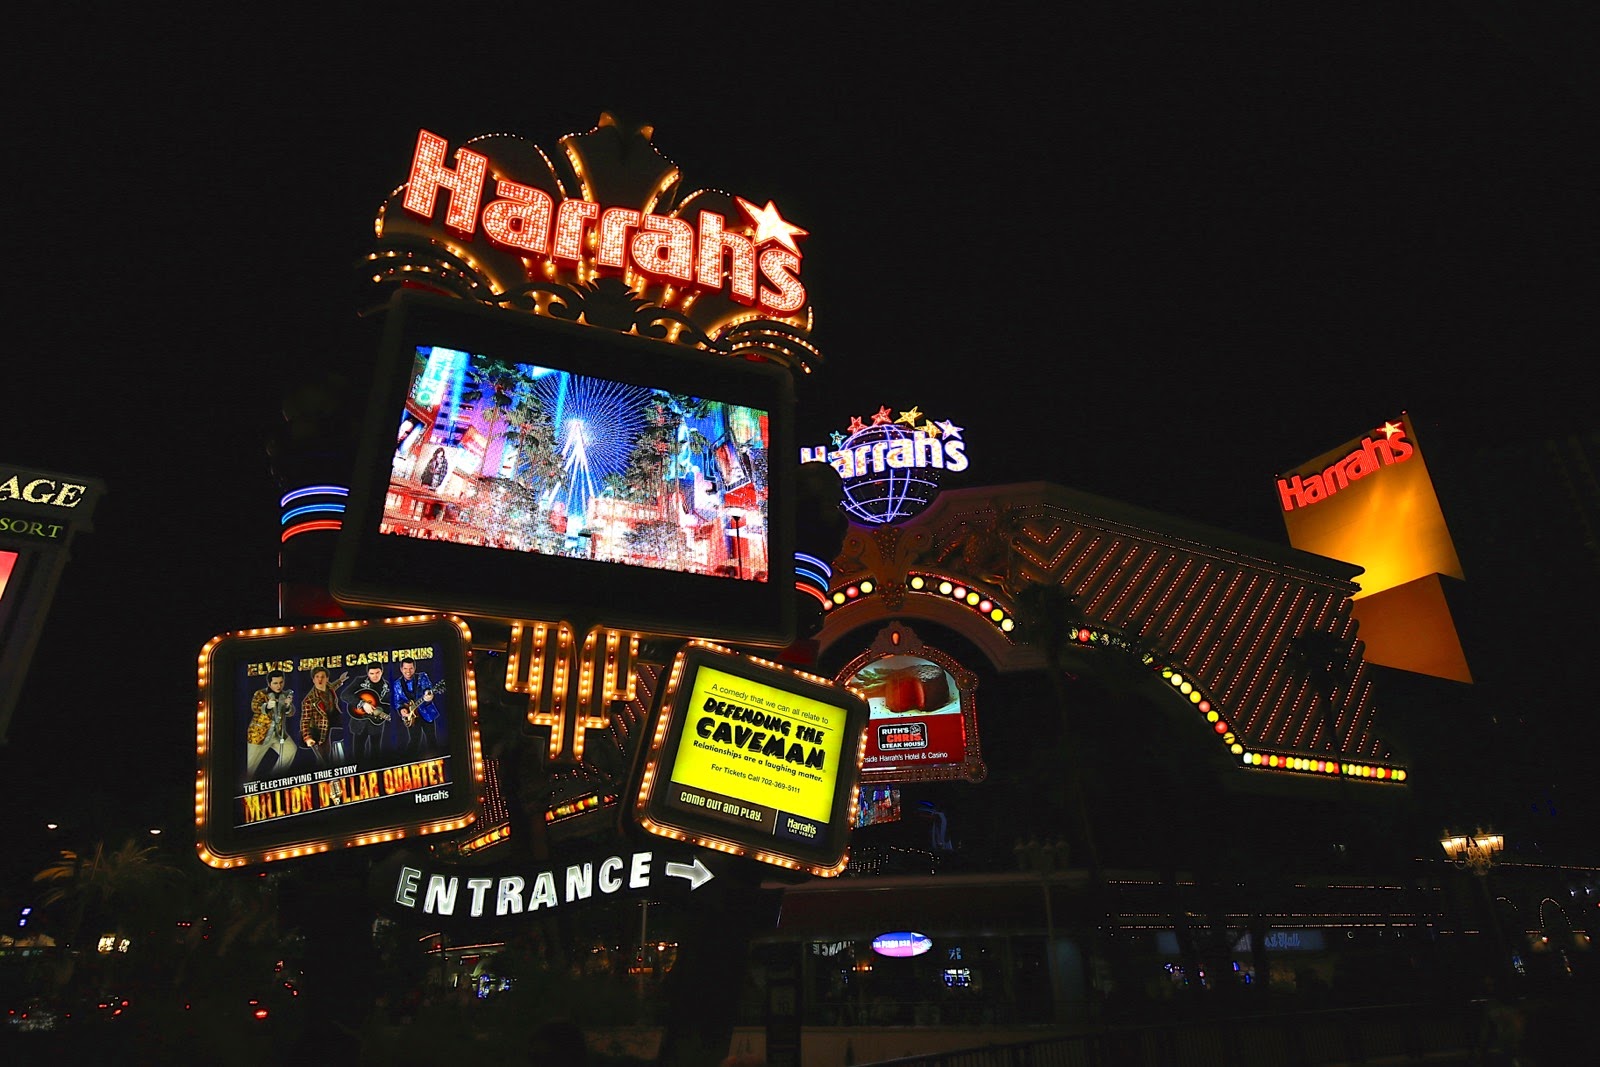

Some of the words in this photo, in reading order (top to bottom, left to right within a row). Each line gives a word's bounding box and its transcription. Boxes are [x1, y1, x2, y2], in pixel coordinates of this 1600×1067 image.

[247, 659, 294, 677] ELVIS
[297, 657, 325, 672] JERRY
[326, 655, 343, 669] LEE
[346, 650, 390, 667] CASH
[391, 646, 434, 663] PERKINS
[703, 697, 792, 737] DEFENDING
[795, 725, 825, 745] THE
[711, 683, 718, 691] A
[719, 687, 749, 701] comedy
[750, 694, 764, 705] that
[765, 700, 776, 709] we
[777, 703, 790, 713] can
[791, 707, 800, 716] all
[801, 710, 820, 722] relate
[821, 715, 829, 724] to
[696, 717, 826, 770] CAVEMAN
[881, 727, 909, 735] RUTH'S
[693, 740, 742, 760] Relationships
[743, 756, 756, 764] are
[765, 759, 797, 777] laughing
[798, 771, 823, 783] matter.
[864, 755, 878, 763] nside
[879, 753, 904, 762] Harrah's
[904, 751, 920, 760] Hotel
[921, 750, 926, 759] &
[927, 750, 948, 759] Casino
[243, 782, 259, 794] THE
[260, 773, 312, 791] ELECTRIFYING
[313, 768, 333, 781] TRUE
[334, 764, 358, 778] STORY
[243, 784, 313, 823] MILLION
[318, 772, 380, 808] DLLAR
[383, 758, 446, 794] QUARTET
[711, 764, 723, 773] For
[724, 767, 747, 779] Tickets
[748, 773, 760, 783] Call
[761, 777, 801, 794] 702-369-5111
[706, 798, 722, 811] OUT
[395, 850, 653, 919] ENTRANCE
